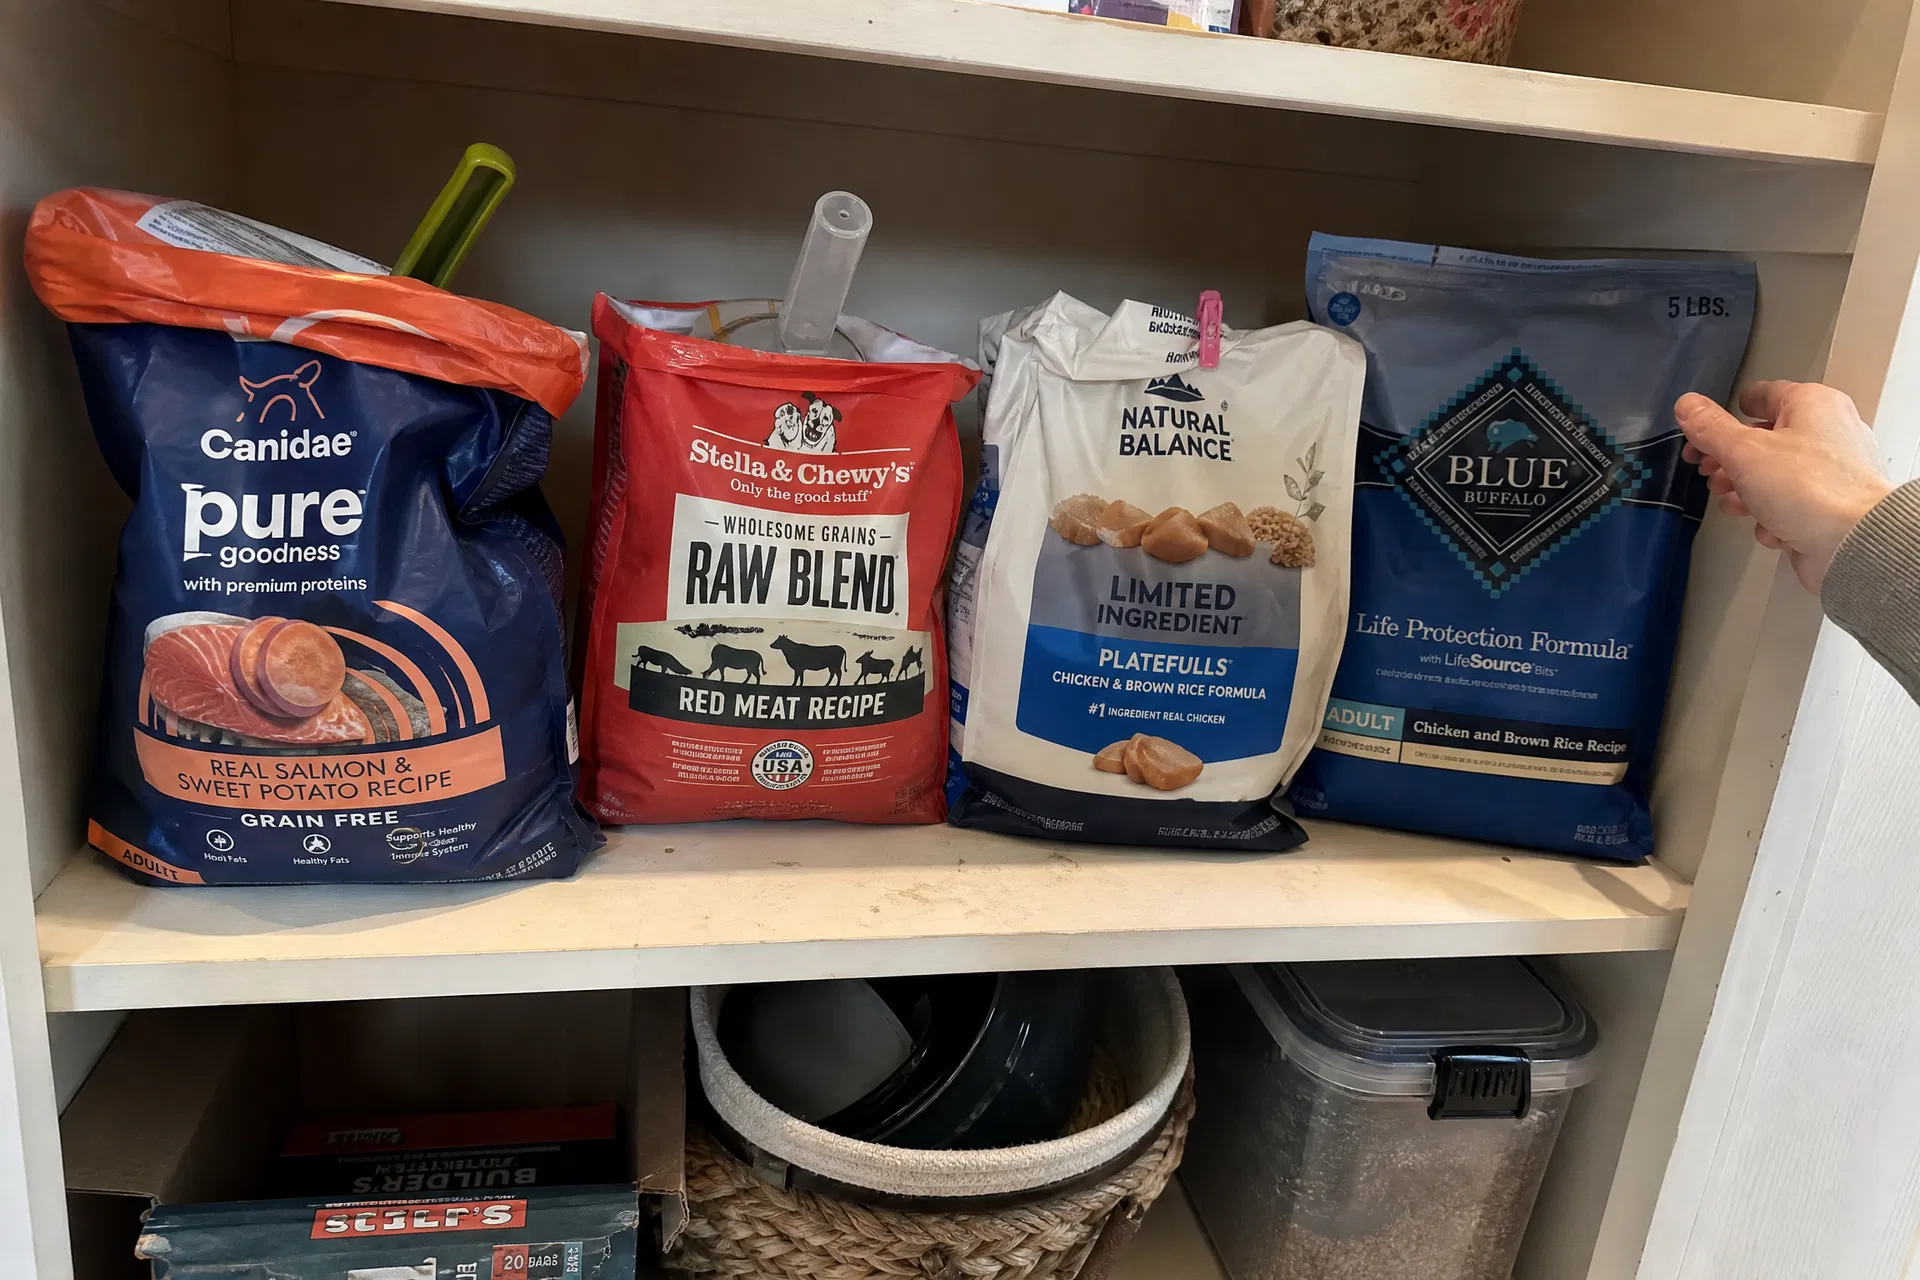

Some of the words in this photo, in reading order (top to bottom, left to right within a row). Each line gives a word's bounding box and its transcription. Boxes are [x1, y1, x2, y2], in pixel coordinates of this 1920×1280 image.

[1667, 296, 1680, 318] 5
[1685, 296, 1730, 318] LBS.
[1121, 405, 1231, 437] NATURAL
[200, 429, 352, 461] Canidae
[1119, 433, 1232, 462] BALANCE
[689, 439, 768, 479] Stella
[771, 459, 793, 482] &
[797, 461, 911, 488] Chewy's
[1446, 455, 1570, 489] BLUE
[730, 479, 764, 498] Only
[767, 486, 791, 500] the
[794, 490, 830, 504] good
[833, 490, 869, 503] stuff
[1464, 490, 1547, 506] BUFFALO
[180, 483, 363, 562] pure
[723, 515, 815, 541] WHOLESOME
[822, 525, 877, 546] GRAINS
[219, 542, 341, 568] goodness
[183, 576, 222, 592] with
[226, 578, 297, 595] premium
[301, 575, 367, 595] proteins
[686, 541, 777, 605] RAW
[787, 547, 896, 614] BLEND
[1110, 575, 1237, 611] LIMITED
[1097, 603, 1243, 635] INGREDIENT
[1356, 612, 1400, 637] Life
[1405, 618, 1524, 651] Protection
[1529, 630, 1629, 660] Formula
[1098, 648, 1228, 676] PLATEFULLS
[1419, 653, 1441, 665] with
[1052, 670, 1109, 689] CHICKEN
[1112, 678, 1122, 690] &
[1126, 679, 1175, 694] BROWN
[1177, 683, 1205, 696] RICE
[1208, 685, 1267, 700] FORMULA
[679, 686, 725, 715] RED
[733, 692, 801, 720] MEAT
[808, 692, 886, 720] RECIPE
[1087, 702, 1106, 718] #1
[1108, 707, 1161, 721] INGREDIENT
[1163, 711, 1184, 722] REAL
[1186, 712, 1225, 725] CHICKEN
[1326, 706, 1395, 731] ADULT
[1413, 720, 1470, 740] Chicken
[1473, 728, 1500, 743] and
[1504, 730, 1550, 748] Brown
[1553, 736, 1584, 751] Rice
[1586, 739, 1627, 756] Recipe
[209, 758, 269, 780] REAL
[275, 757, 386, 780] SALMON
[394, 756, 413, 774] &
[762, 759, 803, 773] USA
[178, 772, 251, 799] SWEET
[260, 778, 360, 801] POTATO
[368, 769, 452, 798] RECIPE
[240, 813, 324, 828] GRAIN
[335, 810, 399, 826] FREE
[438, 821, 477, 836] Healthy
[292, 856, 328, 866] Healthy
[330, 856, 350, 865] Fats
[431, 843, 469, 858] System
[503, 1254, 524, 1271] 20
